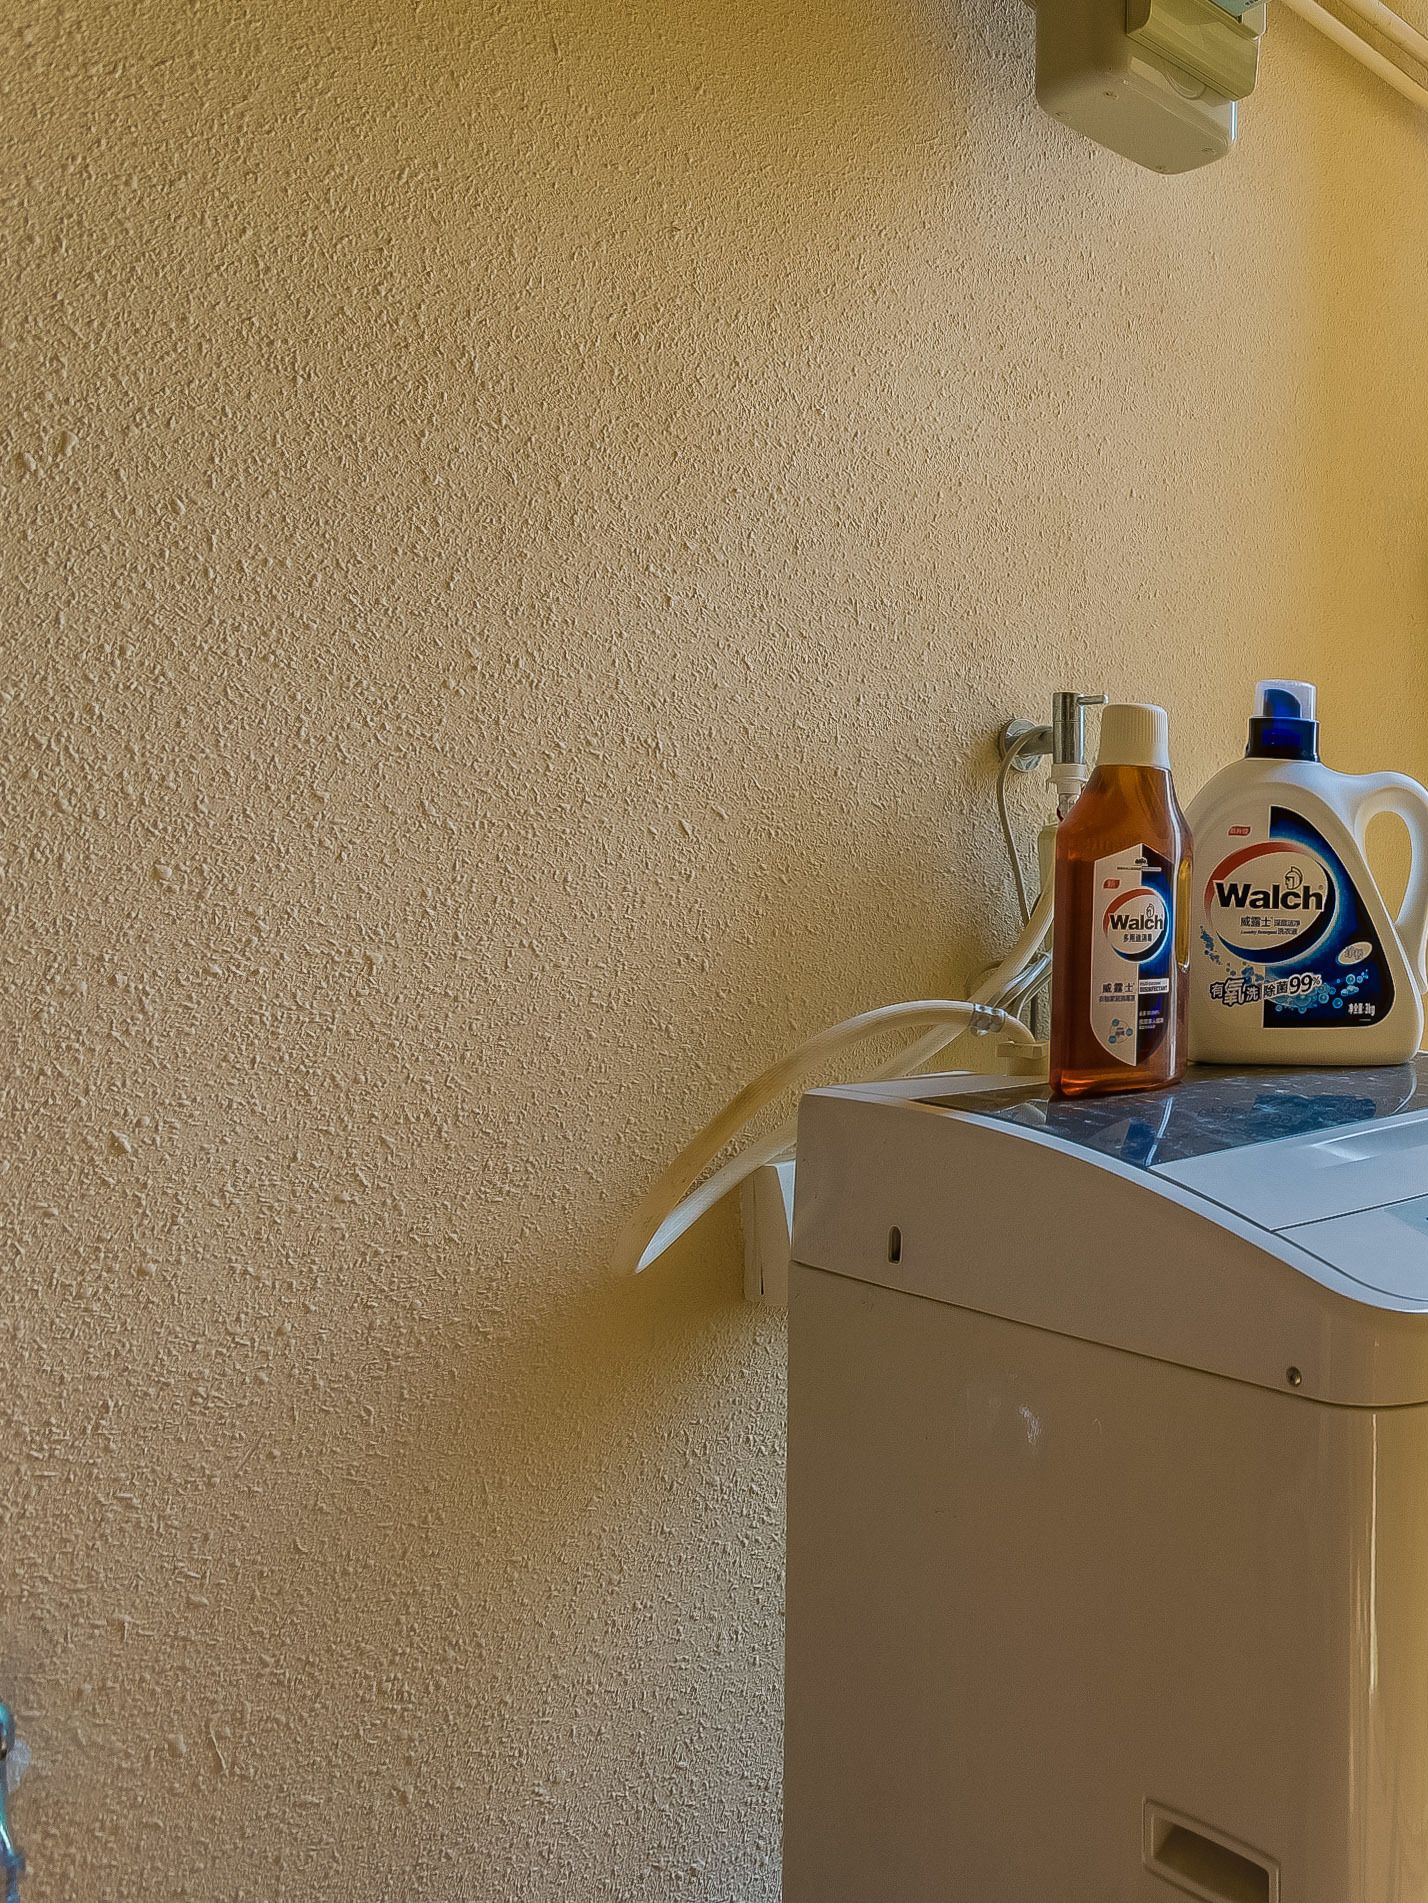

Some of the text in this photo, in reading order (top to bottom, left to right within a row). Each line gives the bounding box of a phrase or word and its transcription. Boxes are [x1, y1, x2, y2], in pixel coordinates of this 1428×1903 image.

[1214, 882, 1323, 910] Walch
[1110, 914, 1163, 930] Walch
[1210, 977, 1260, 1006] 有氧洗
